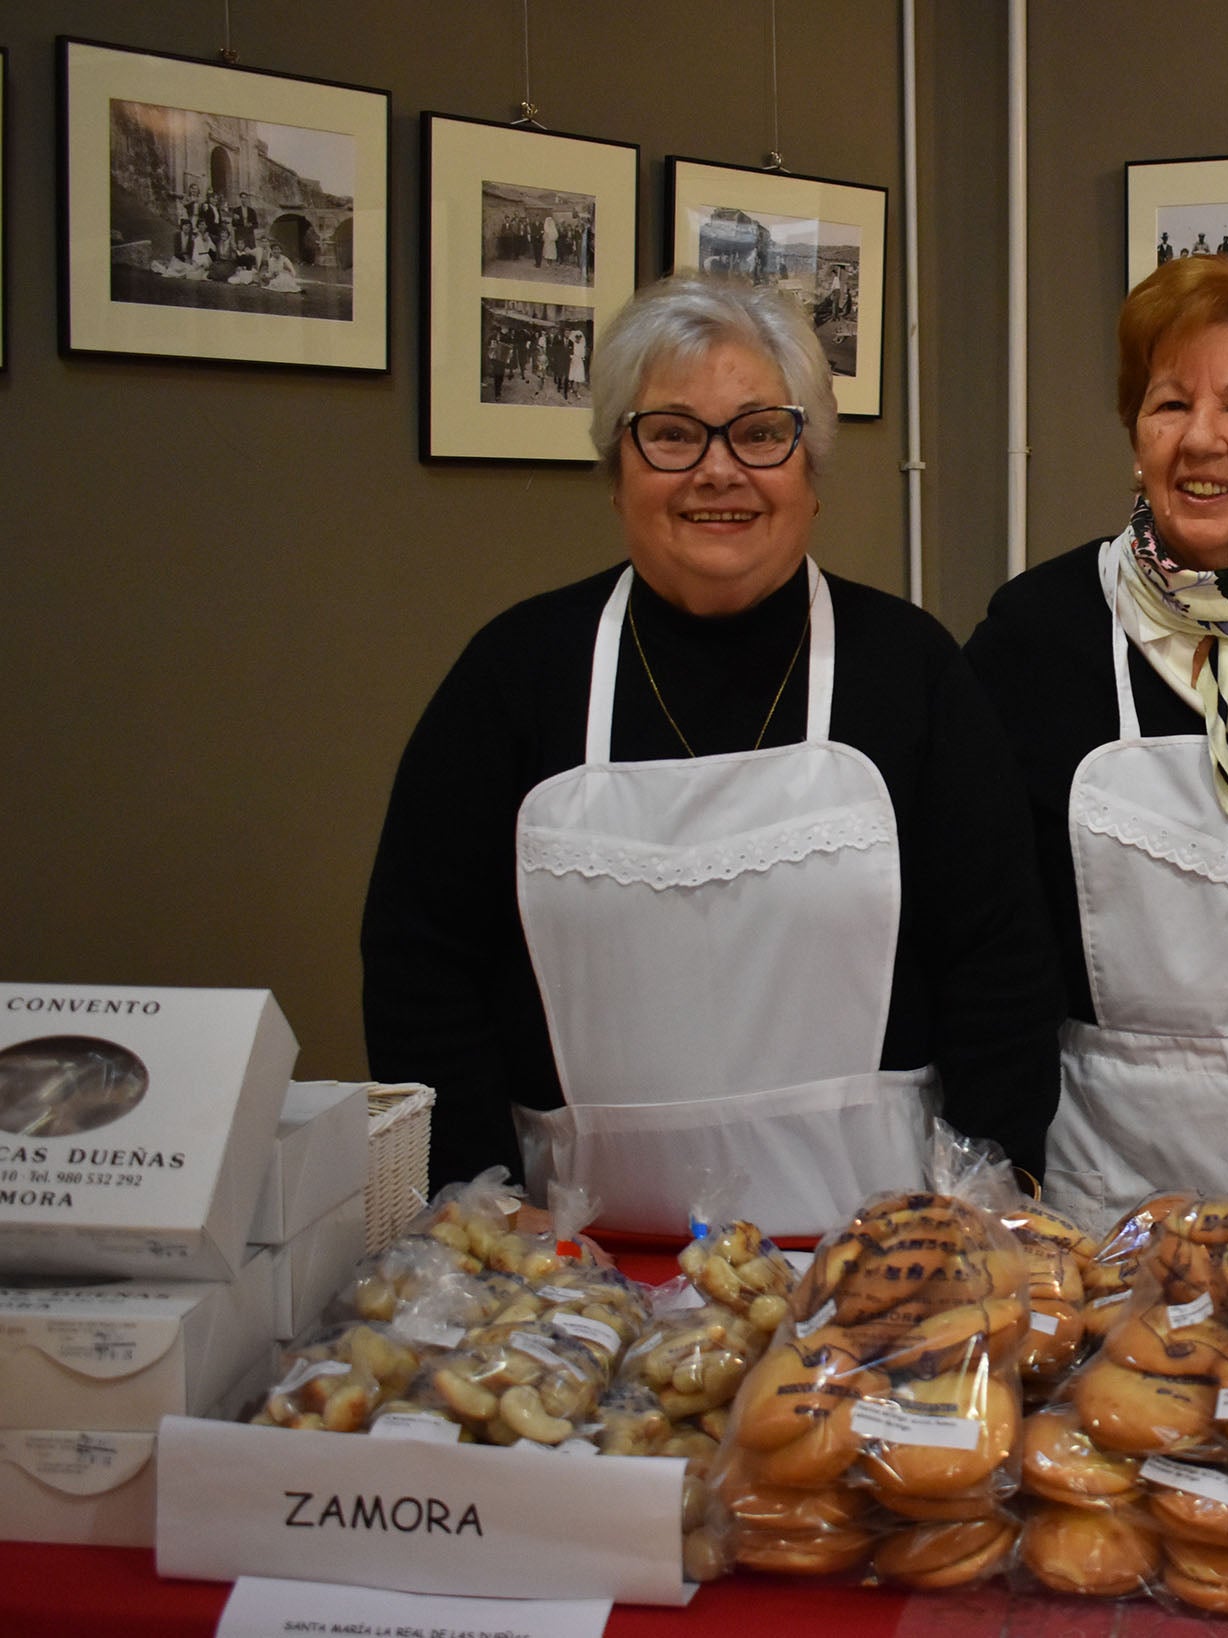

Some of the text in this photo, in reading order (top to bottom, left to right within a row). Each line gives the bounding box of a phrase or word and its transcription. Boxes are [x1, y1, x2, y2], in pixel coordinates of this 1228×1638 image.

[7, 996, 162, 1015] CONVENTO
[68, 1147, 187, 1169] DUEÑAS
[29, 1171, 51, 1184] Tel.
[57, 1172, 83, 1184] 980
[86, 1173, 112, 1185] 532
[115, 1174, 143, 1187] 292
[285, 1491, 483, 1537] ZAMORA
[284, 1621, 327, 1633] SANTA
[331, 1622, 372, 1635] MARÍA
[376, 1626, 392, 1637] LA
[396, 1626, 425, 1638] REAL
[431, 1628, 448, 1638] DE
